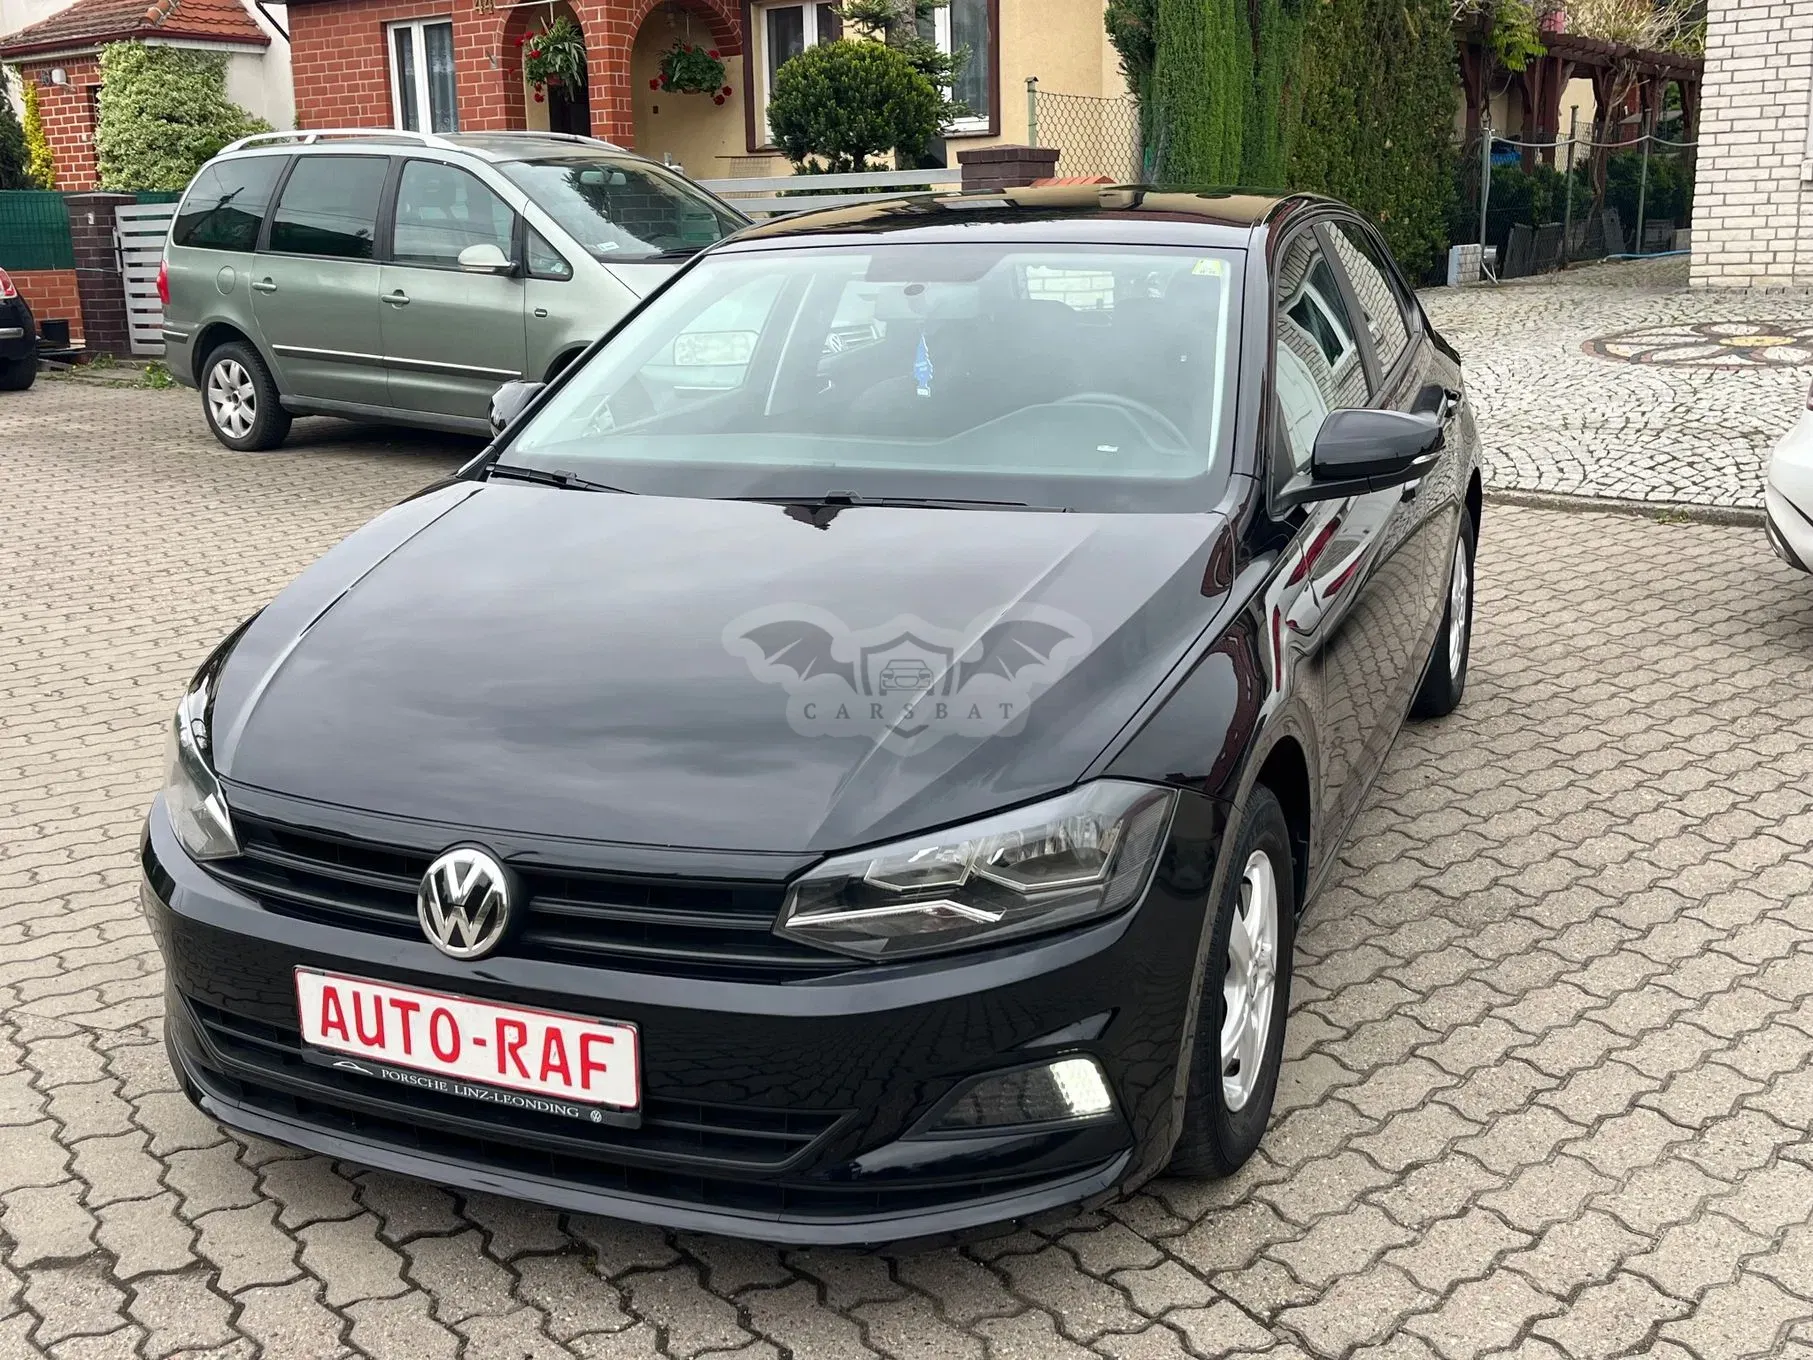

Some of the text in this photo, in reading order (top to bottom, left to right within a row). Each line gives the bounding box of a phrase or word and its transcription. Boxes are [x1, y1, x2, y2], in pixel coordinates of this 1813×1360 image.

[321, 984, 615, 1090] AUTO-RAF
[381, 1068, 580, 1118] PORSCHE LINZ-LEONDING
